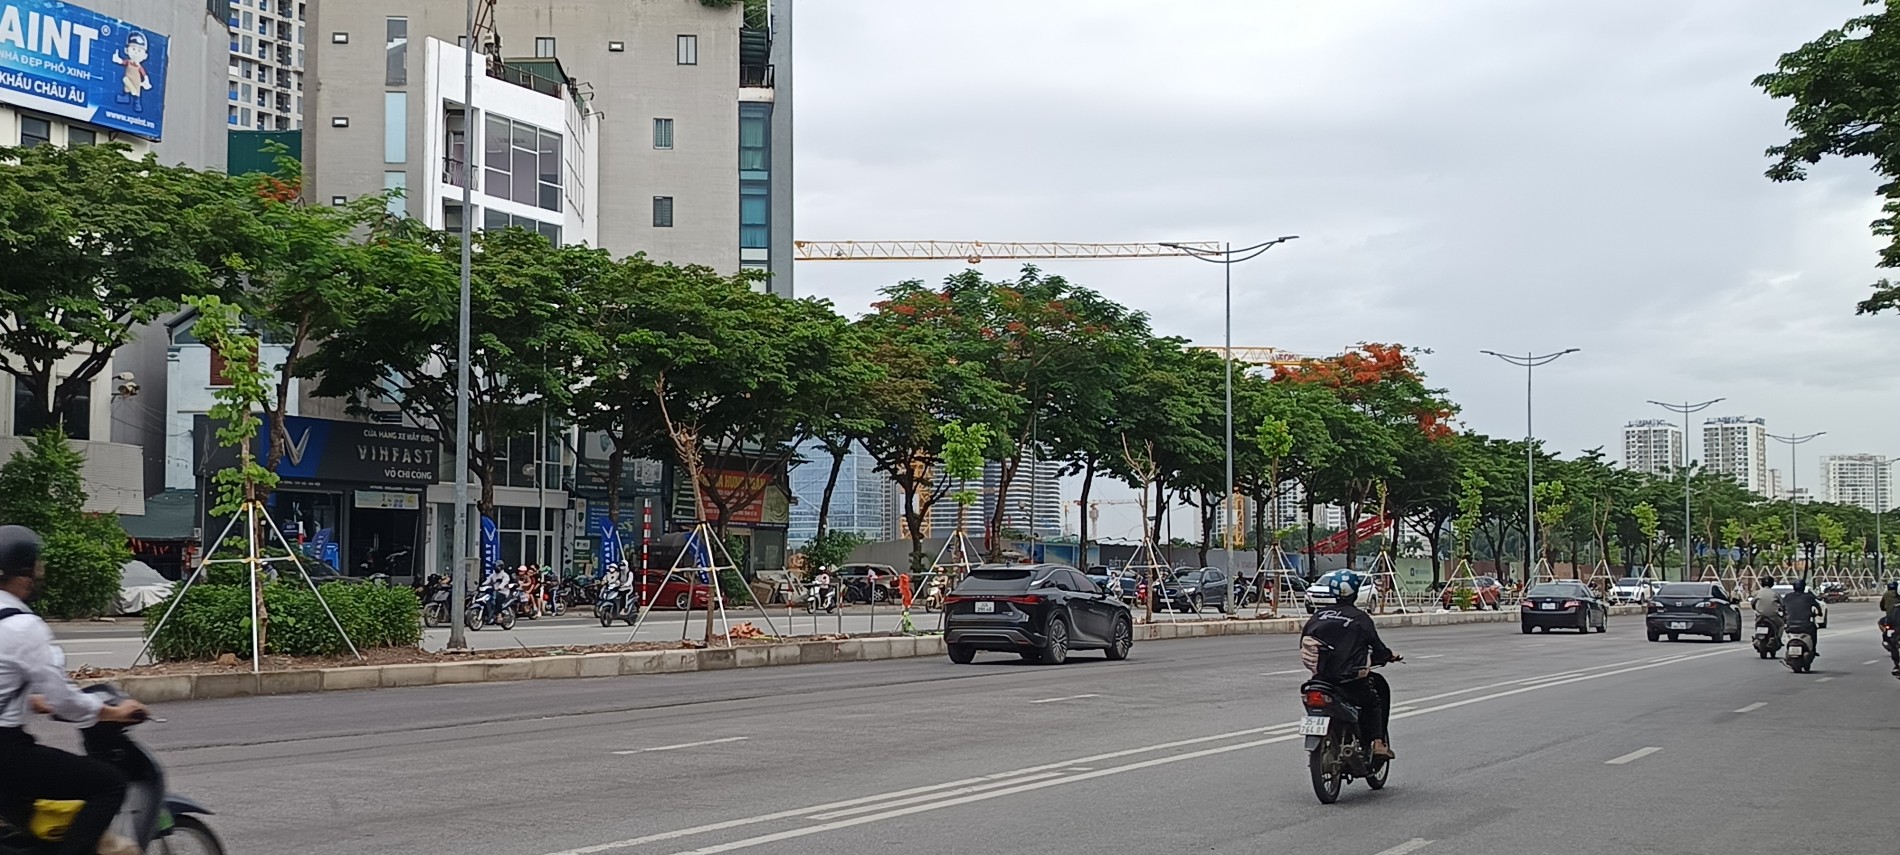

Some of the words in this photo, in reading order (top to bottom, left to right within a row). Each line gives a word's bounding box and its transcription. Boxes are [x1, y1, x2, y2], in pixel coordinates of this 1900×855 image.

[0, 5, 99, 66] AINT
[20, 55, 42, 67] ĐẸP
[44, 61, 66, 73] PHỐ
[67, 66, 91, 80] XINH
[34, 81, 67, 98] CHÂU
[68, 86, 85, 103] ÂU
[105, 110, 155, 129] www.xpaint.vn
[398, 432, 406, 440] XE
[357, 444, 433, 465] VINFAST
[384, 466, 396, 478] VÕ
[397, 468, 411, 479] CHÍ
[411, 468, 432, 480] CÔNG
